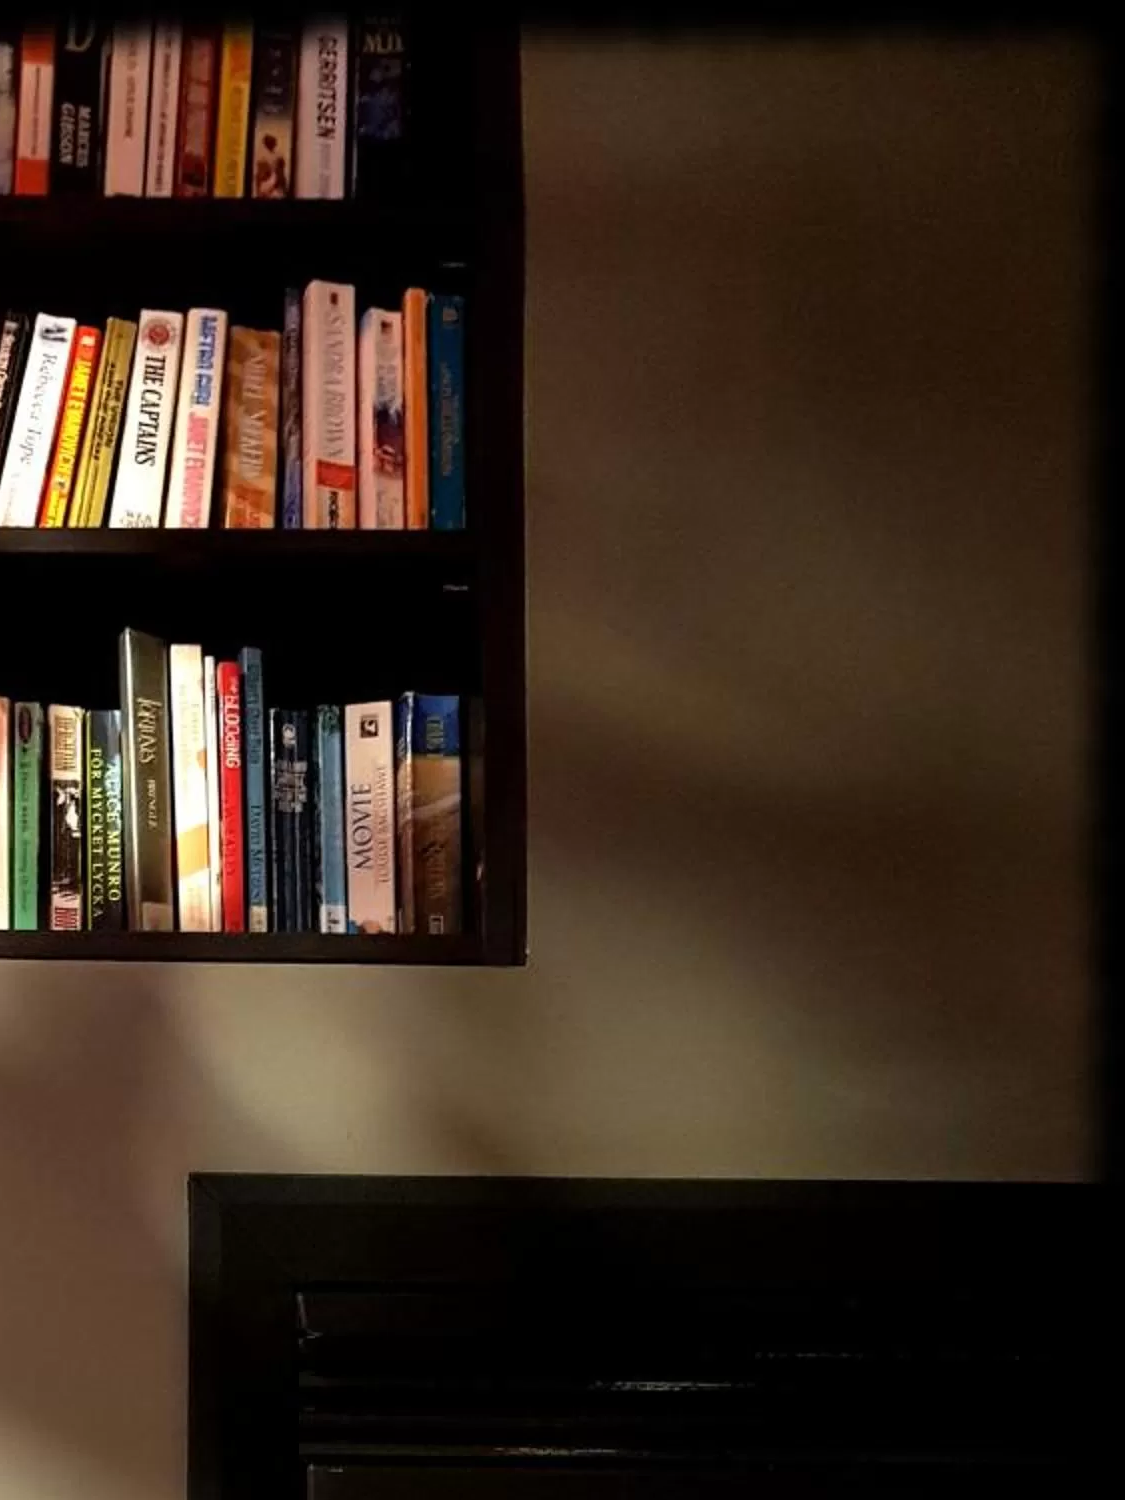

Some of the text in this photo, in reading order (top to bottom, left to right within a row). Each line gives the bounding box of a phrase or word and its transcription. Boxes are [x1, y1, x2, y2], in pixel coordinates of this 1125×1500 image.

[316, 37, 339, 140] GERRITSEN
[197, 316, 219, 370] METRO
[324, 311, 348, 462] SANDRA BROWN
[18, 352, 59, 466] Rebecca Tope
[57, 359, 93, 473] JANET EVANOVICH
[134, 355, 167, 466] THE CAPTAINS
[188, 412, 209, 456] JANET
[91, 787, 105, 853] MYCKET
[105, 763, 122, 902] ALICE MUNRO
[248, 804, 263, 846] DAVID
[351, 784, 373, 870] MOVIE
[91, 862, 104, 918] LYCKA
